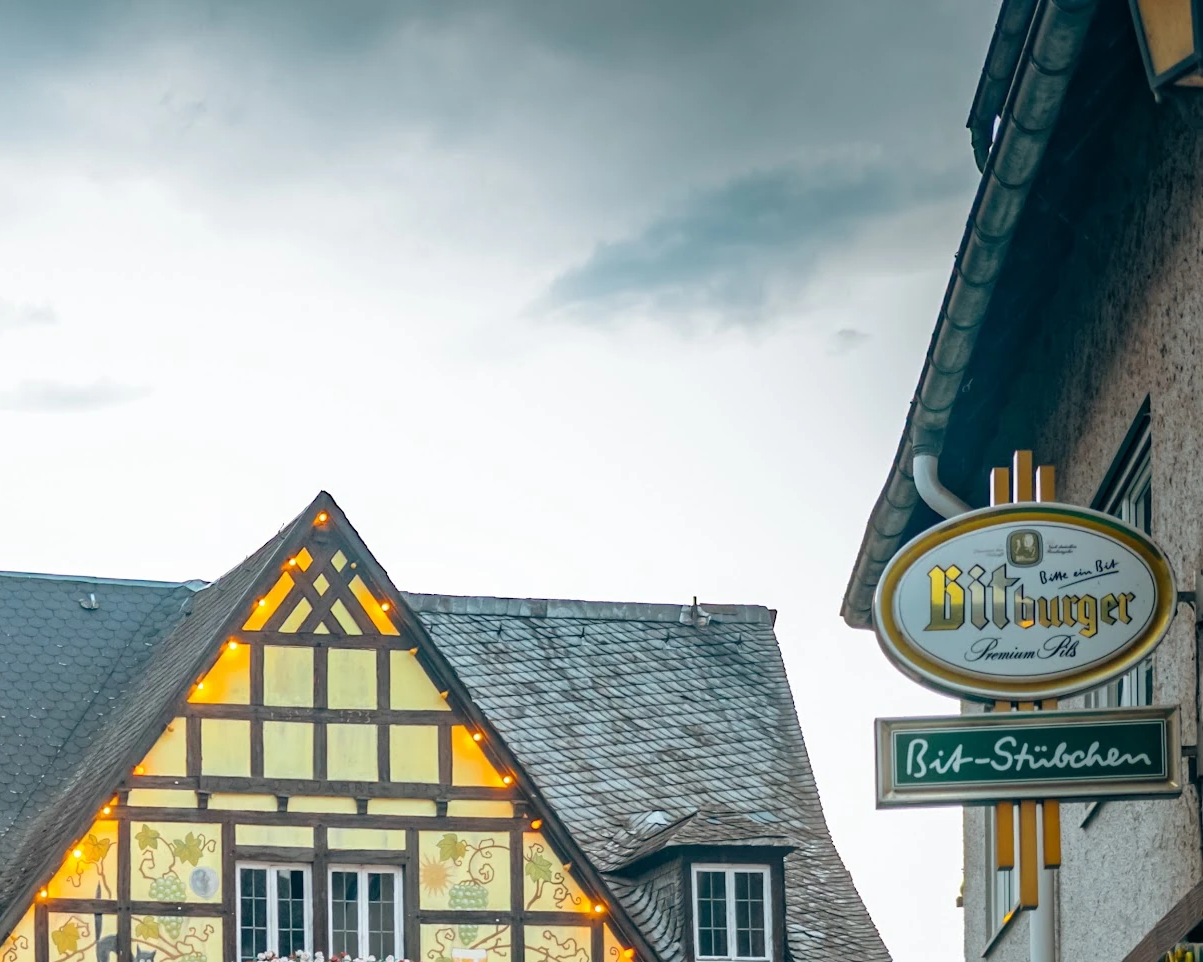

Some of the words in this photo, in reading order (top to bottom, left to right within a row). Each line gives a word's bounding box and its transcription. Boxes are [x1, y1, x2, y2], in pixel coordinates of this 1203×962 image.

[1039, 570, 1069, 585] Bitte
[1073, 568, 1092, 578] ein
[1095, 559, 1119, 573] Bit
[923, 563, 1136, 639] Bitburger
[964, 637, 1037, 662] Premium
[1037, 633, 1079, 660] Pils
[906, 736, 1152, 778] Bit-Stübchen
